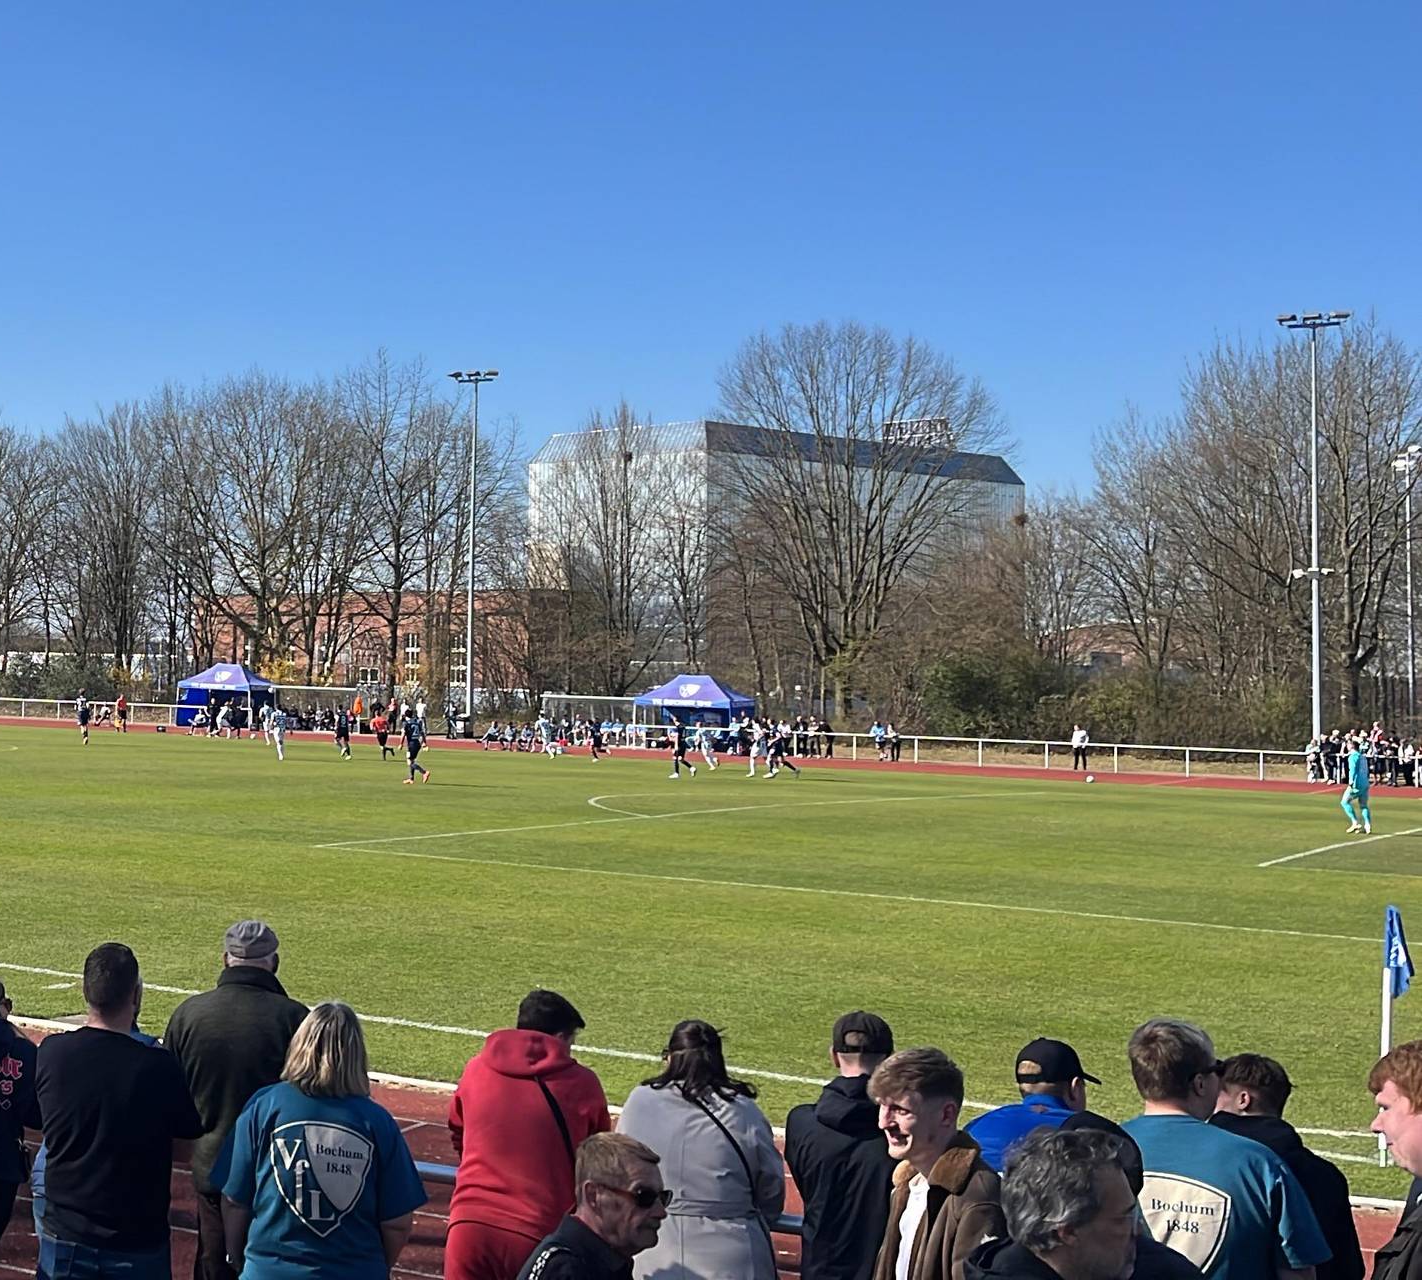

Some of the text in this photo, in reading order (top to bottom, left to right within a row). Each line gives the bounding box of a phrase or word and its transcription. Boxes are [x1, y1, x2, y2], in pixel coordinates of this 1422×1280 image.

[316, 1143, 364, 1160] Bochum
[325, 1162, 352, 1176] 1848
[275, 1138, 335, 1220] VfL
[1151, 1198, 1215, 1216] Bochum
[1166, 1218, 1199, 1234] 1848
